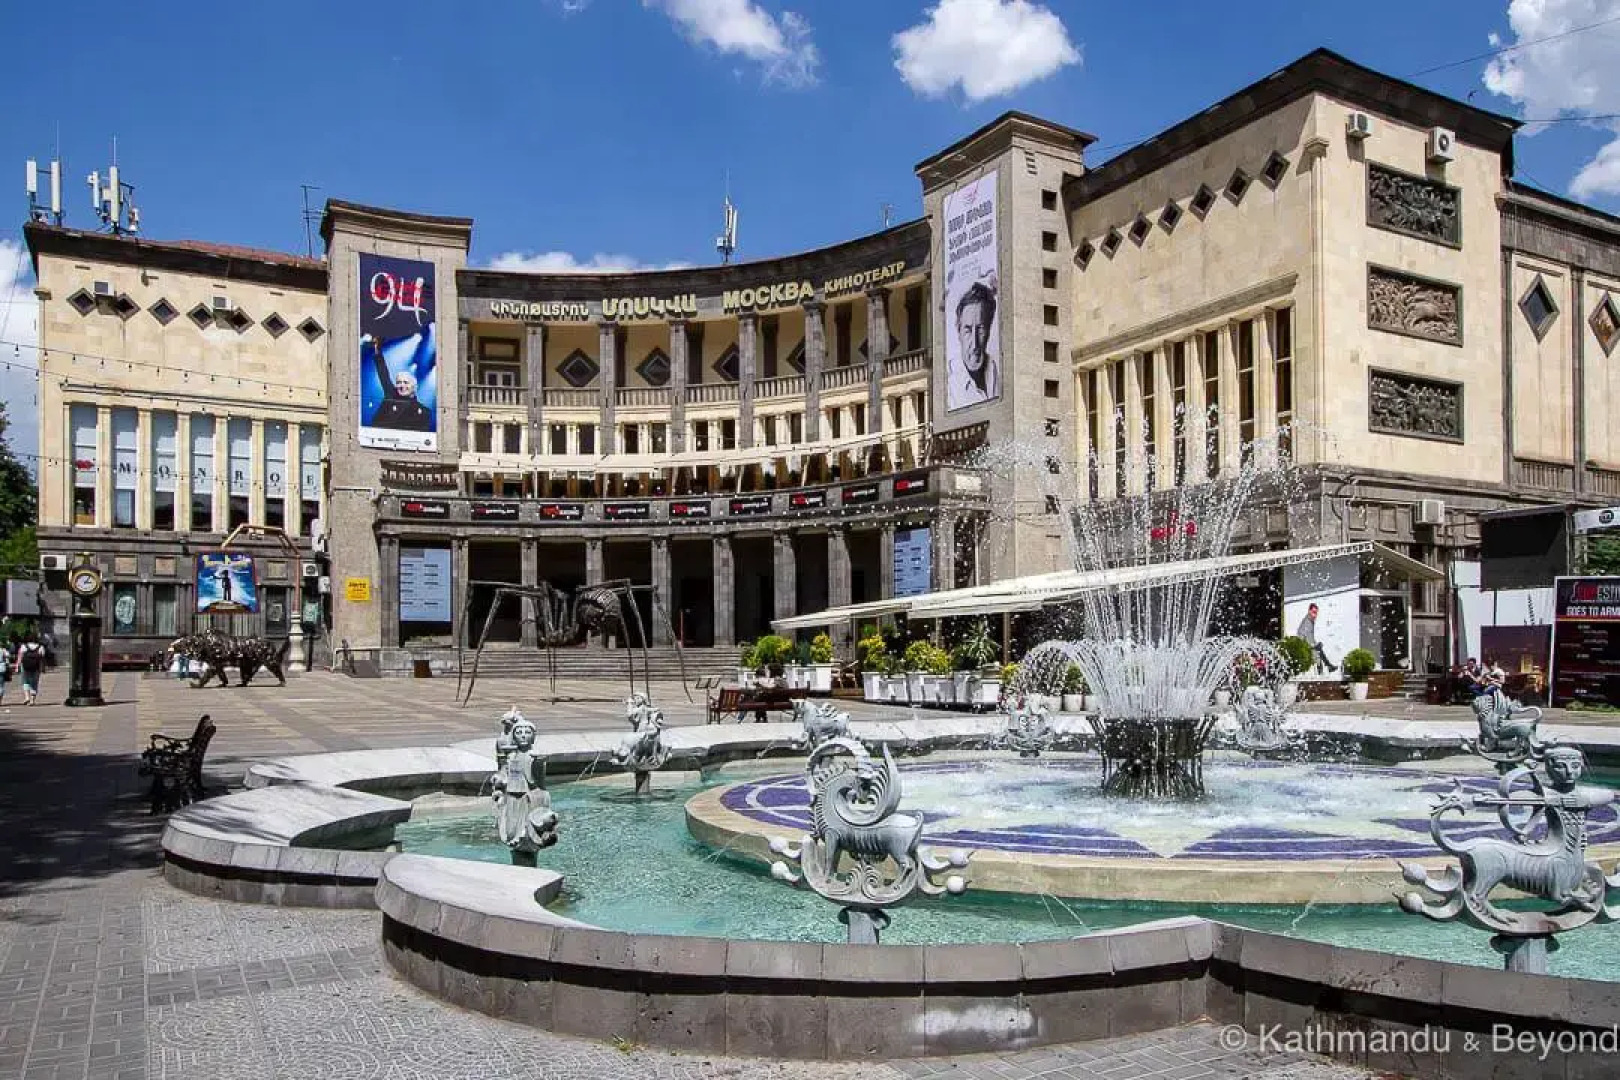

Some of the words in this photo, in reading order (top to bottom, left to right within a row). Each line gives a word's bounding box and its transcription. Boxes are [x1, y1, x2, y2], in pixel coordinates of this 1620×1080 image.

[723, 281, 814, 309] МОСКВА
[824, 261, 906, 293] КИНОТЕАТР
[602, 294, 697, 315] ՄՈՍԿՎԱ
